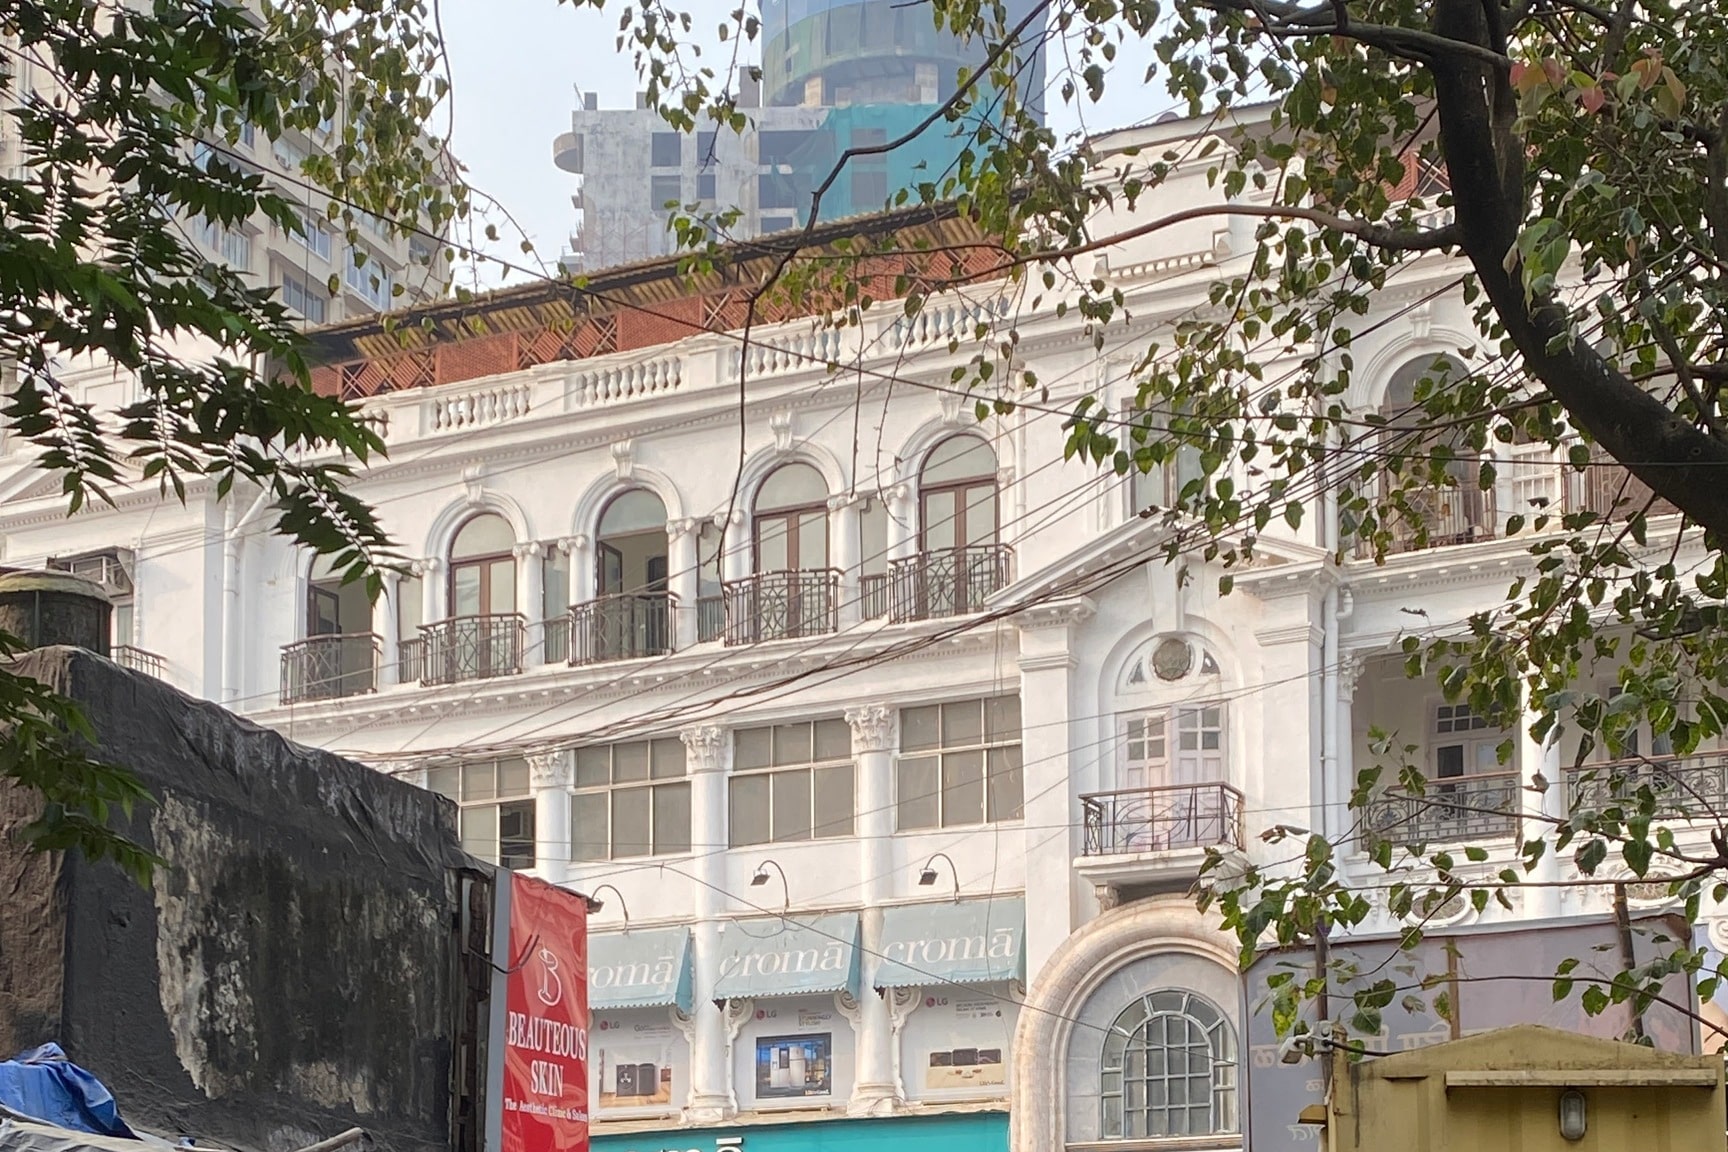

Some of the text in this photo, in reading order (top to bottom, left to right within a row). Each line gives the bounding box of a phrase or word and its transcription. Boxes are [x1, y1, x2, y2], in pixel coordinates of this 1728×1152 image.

[590, 955, 675, 988] omā
[508, 1011, 587, 1061] BEAUTEOUS
[531, 1059, 565, 1098] SKIN
[504, 1096, 517, 1112] The
